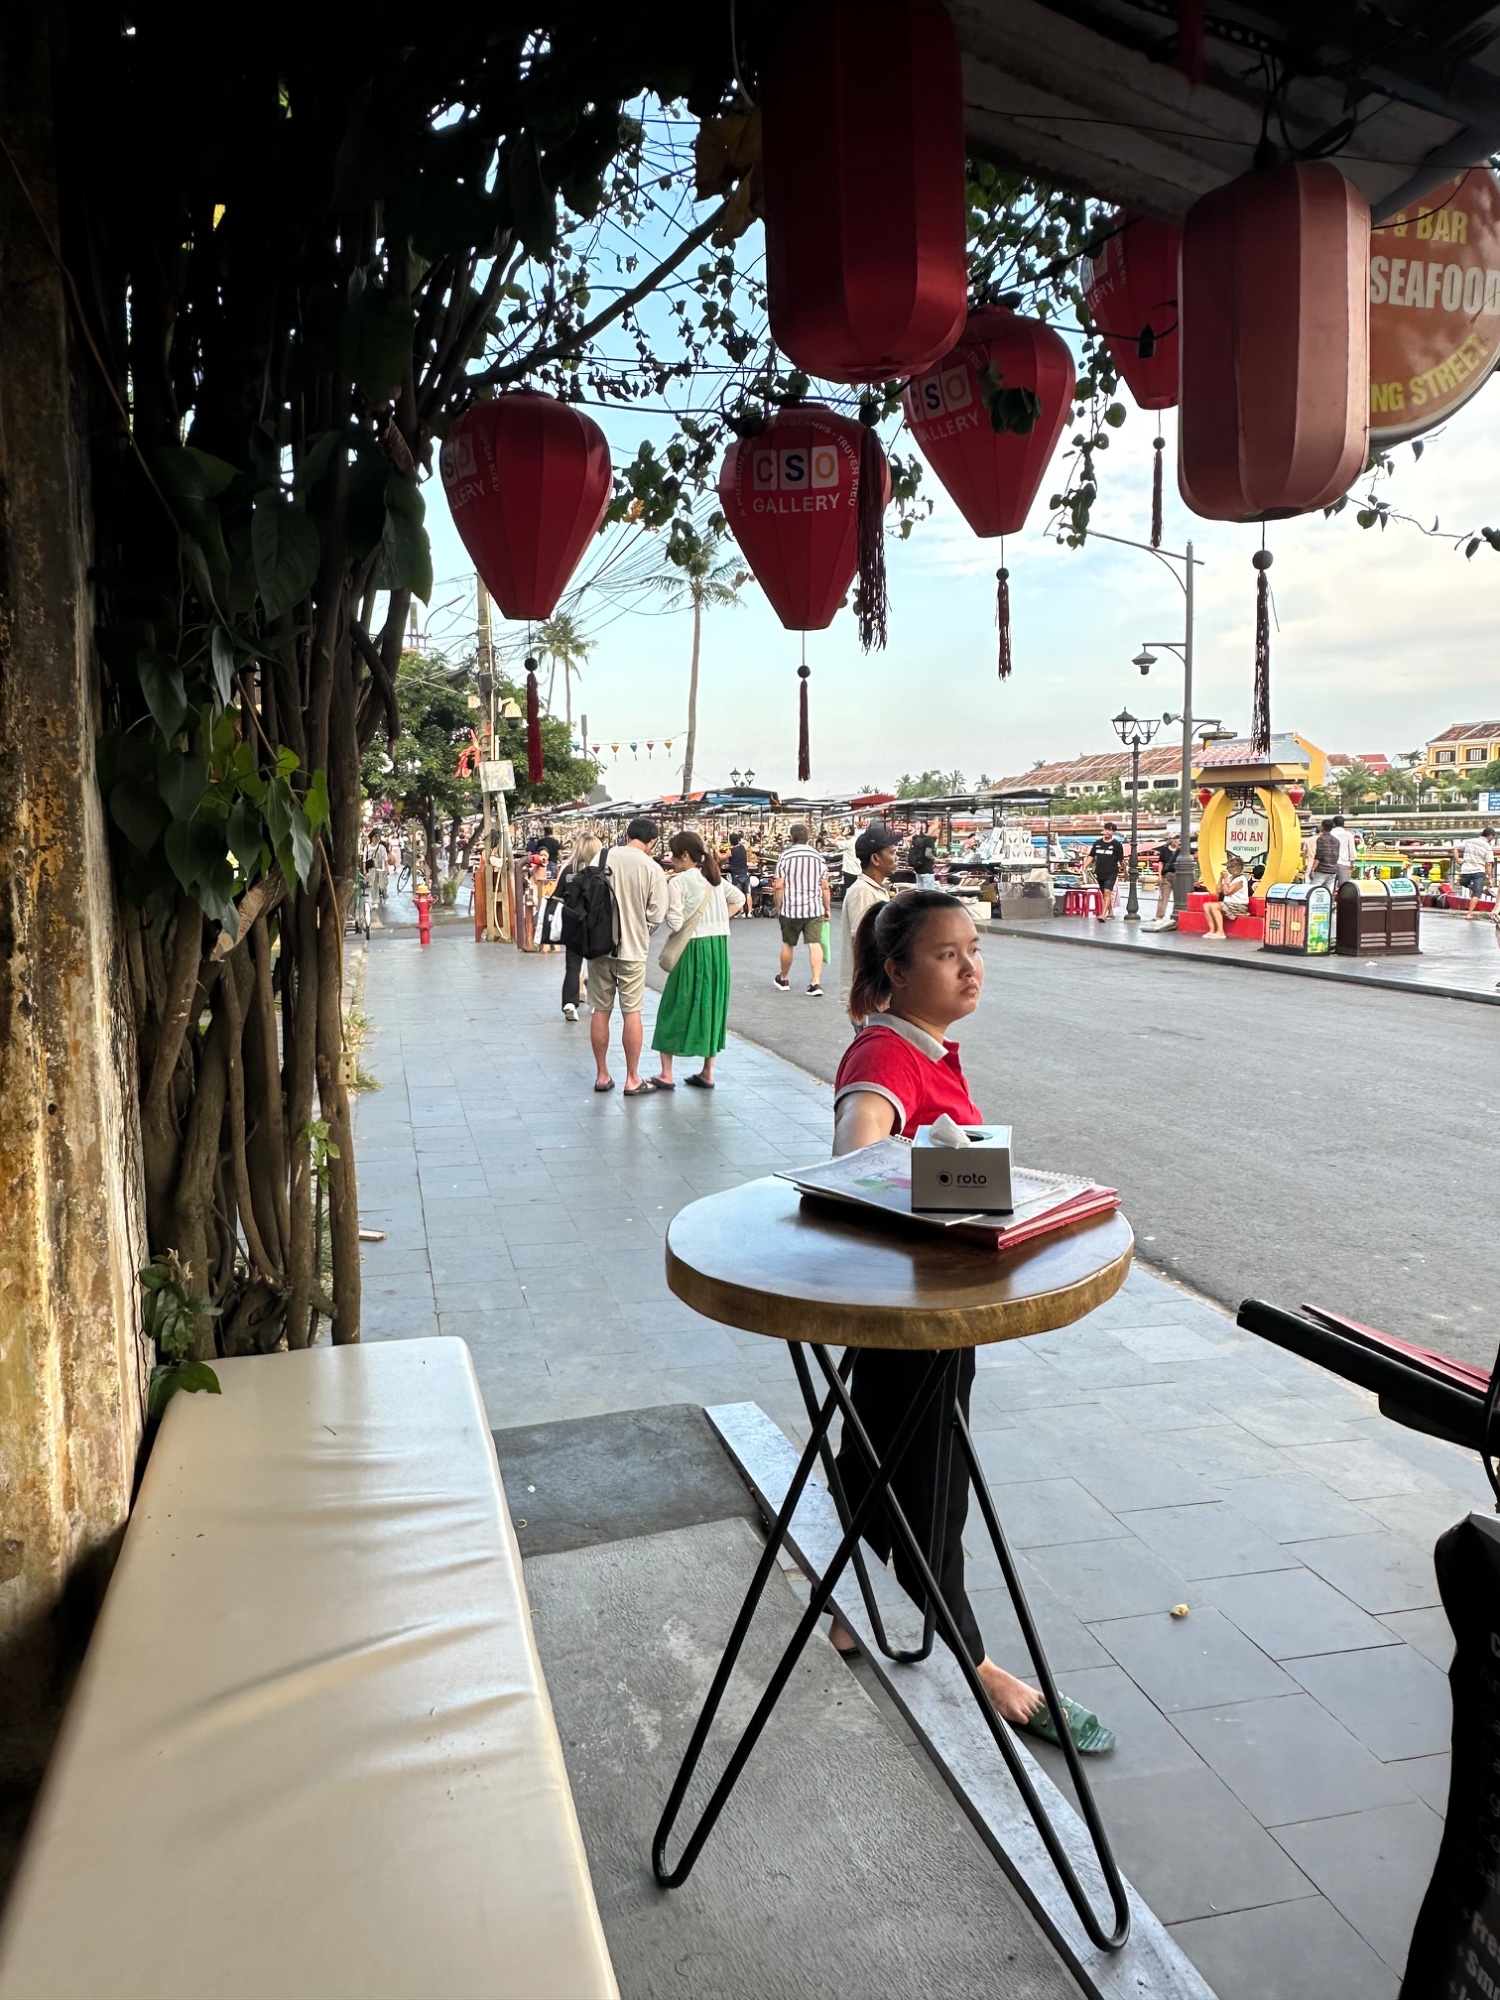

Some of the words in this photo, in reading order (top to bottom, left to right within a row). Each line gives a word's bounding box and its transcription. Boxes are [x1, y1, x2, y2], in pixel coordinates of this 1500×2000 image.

[1416, 206, 1468, 244] BAR
[1369, 256, 1500, 316] SEAFOOD
[1409, 333, 1489, 407] STREET
[755, 452, 836, 483] CSO
[836, 434, 860, 475] TRUYEN
[752, 492, 840, 514] GALLERY
[847, 478, 860, 507] KIEU
[1249, 831, 1264, 842] AN
